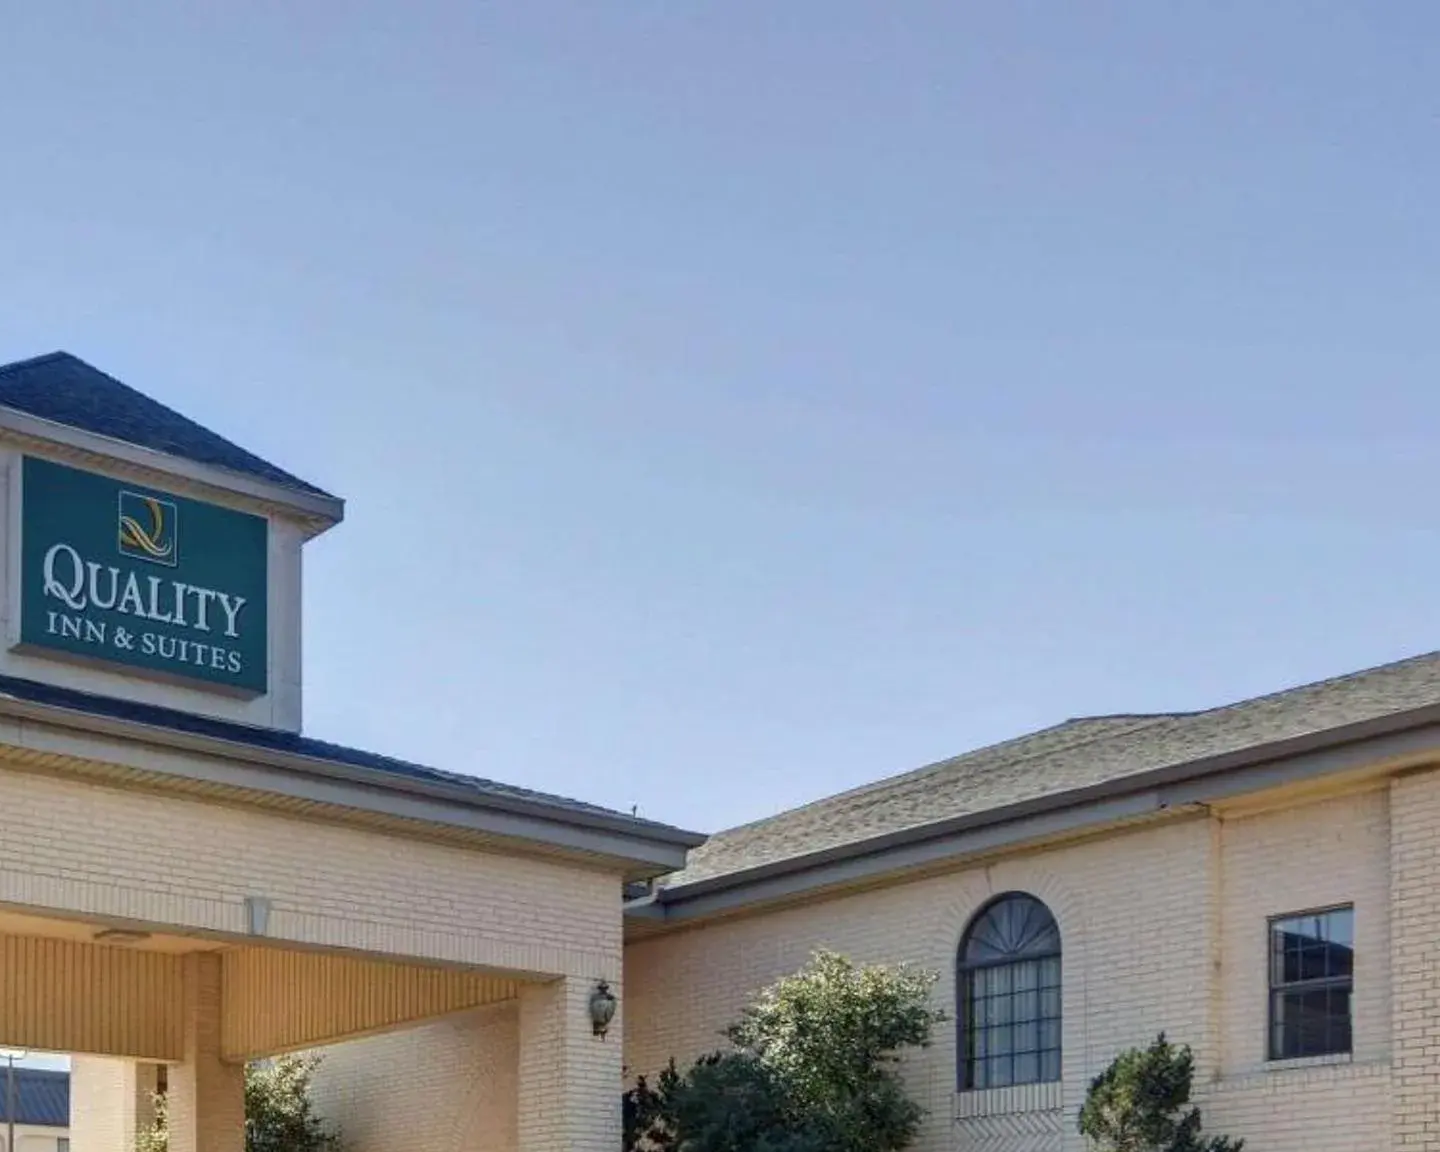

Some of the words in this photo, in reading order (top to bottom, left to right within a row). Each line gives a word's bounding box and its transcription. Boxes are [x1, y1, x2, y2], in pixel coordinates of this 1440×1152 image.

[43, 543, 247, 638] QUALITY
[47, 612, 106, 644] INN
[114, 626, 134, 650] &
[141, 632, 242, 673] SUITES
